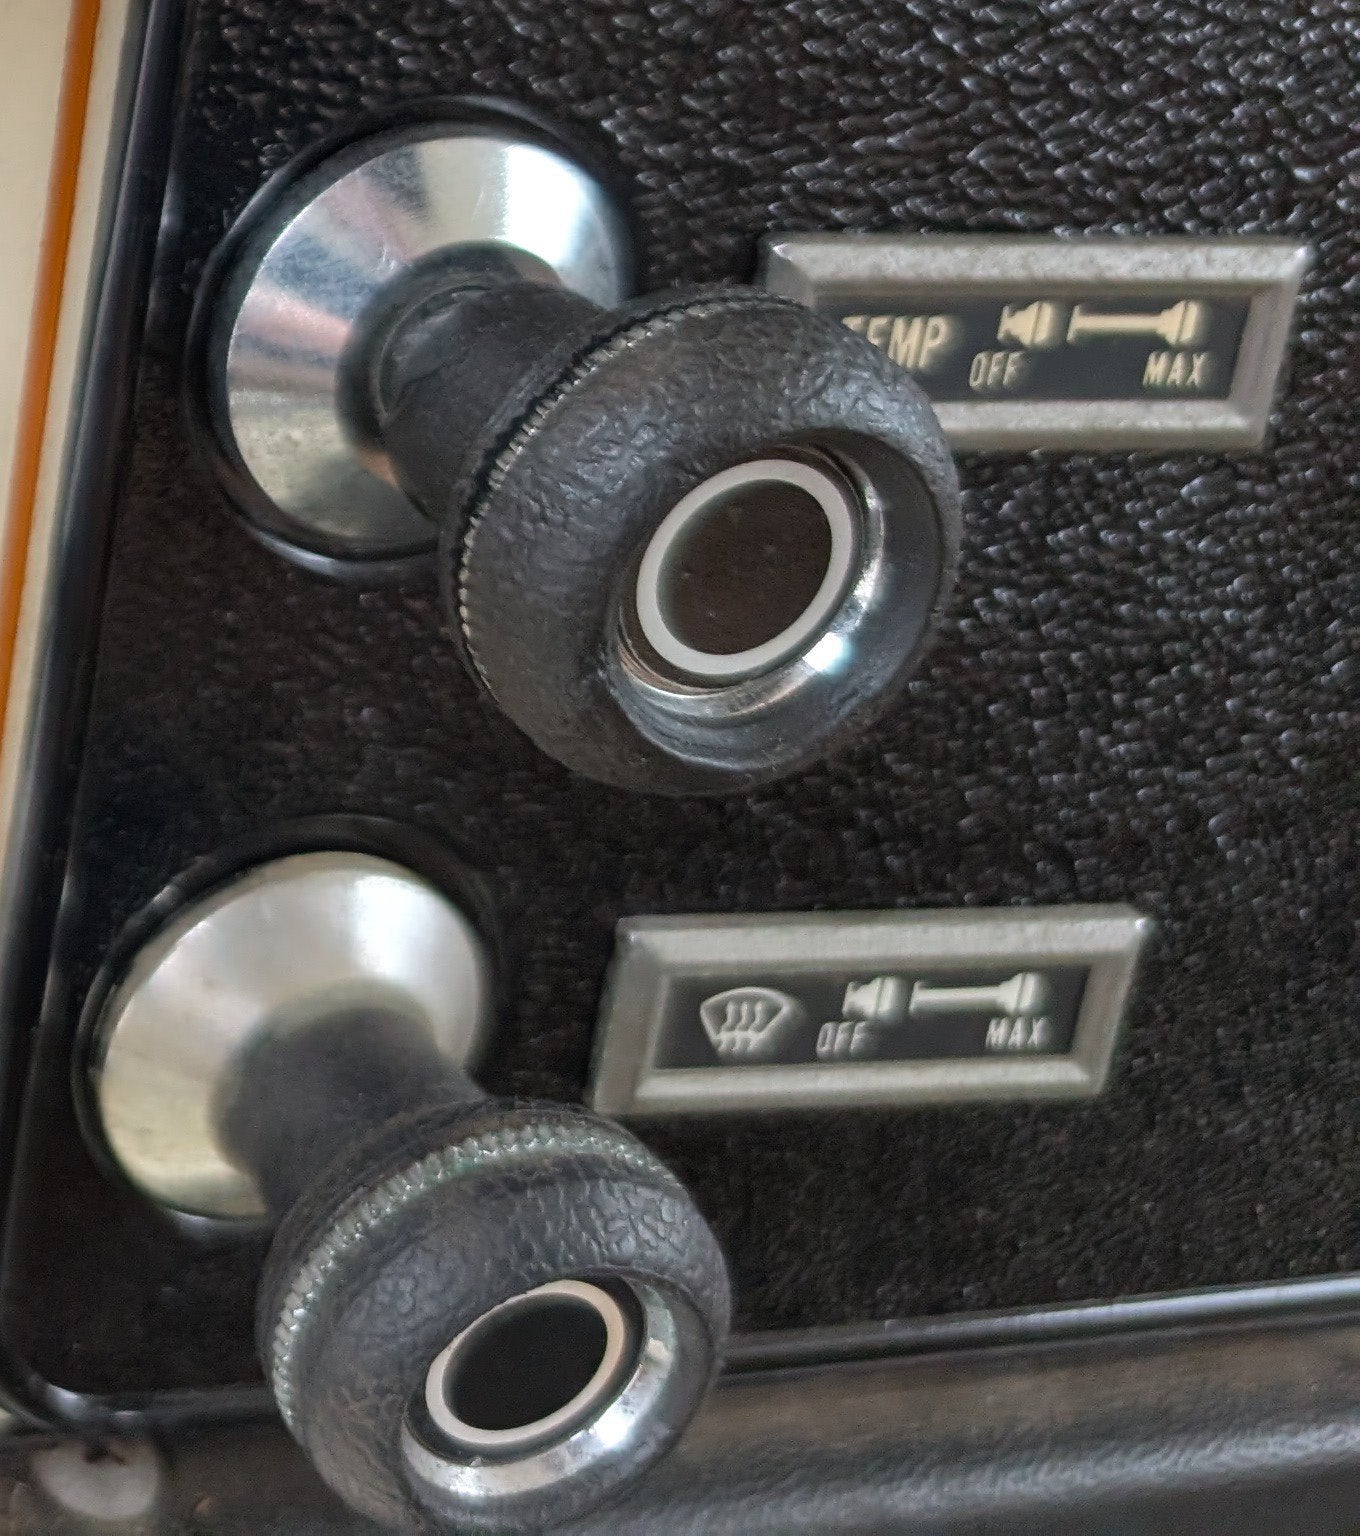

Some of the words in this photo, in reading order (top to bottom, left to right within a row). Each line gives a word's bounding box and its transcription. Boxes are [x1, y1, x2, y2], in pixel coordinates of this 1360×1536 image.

[969, 350, 1025, 391] OFF
[1142, 350, 1208, 390] MAX
[815, 1020, 870, 1059] OFF
[985, 1016, 1048, 1050] MAX
